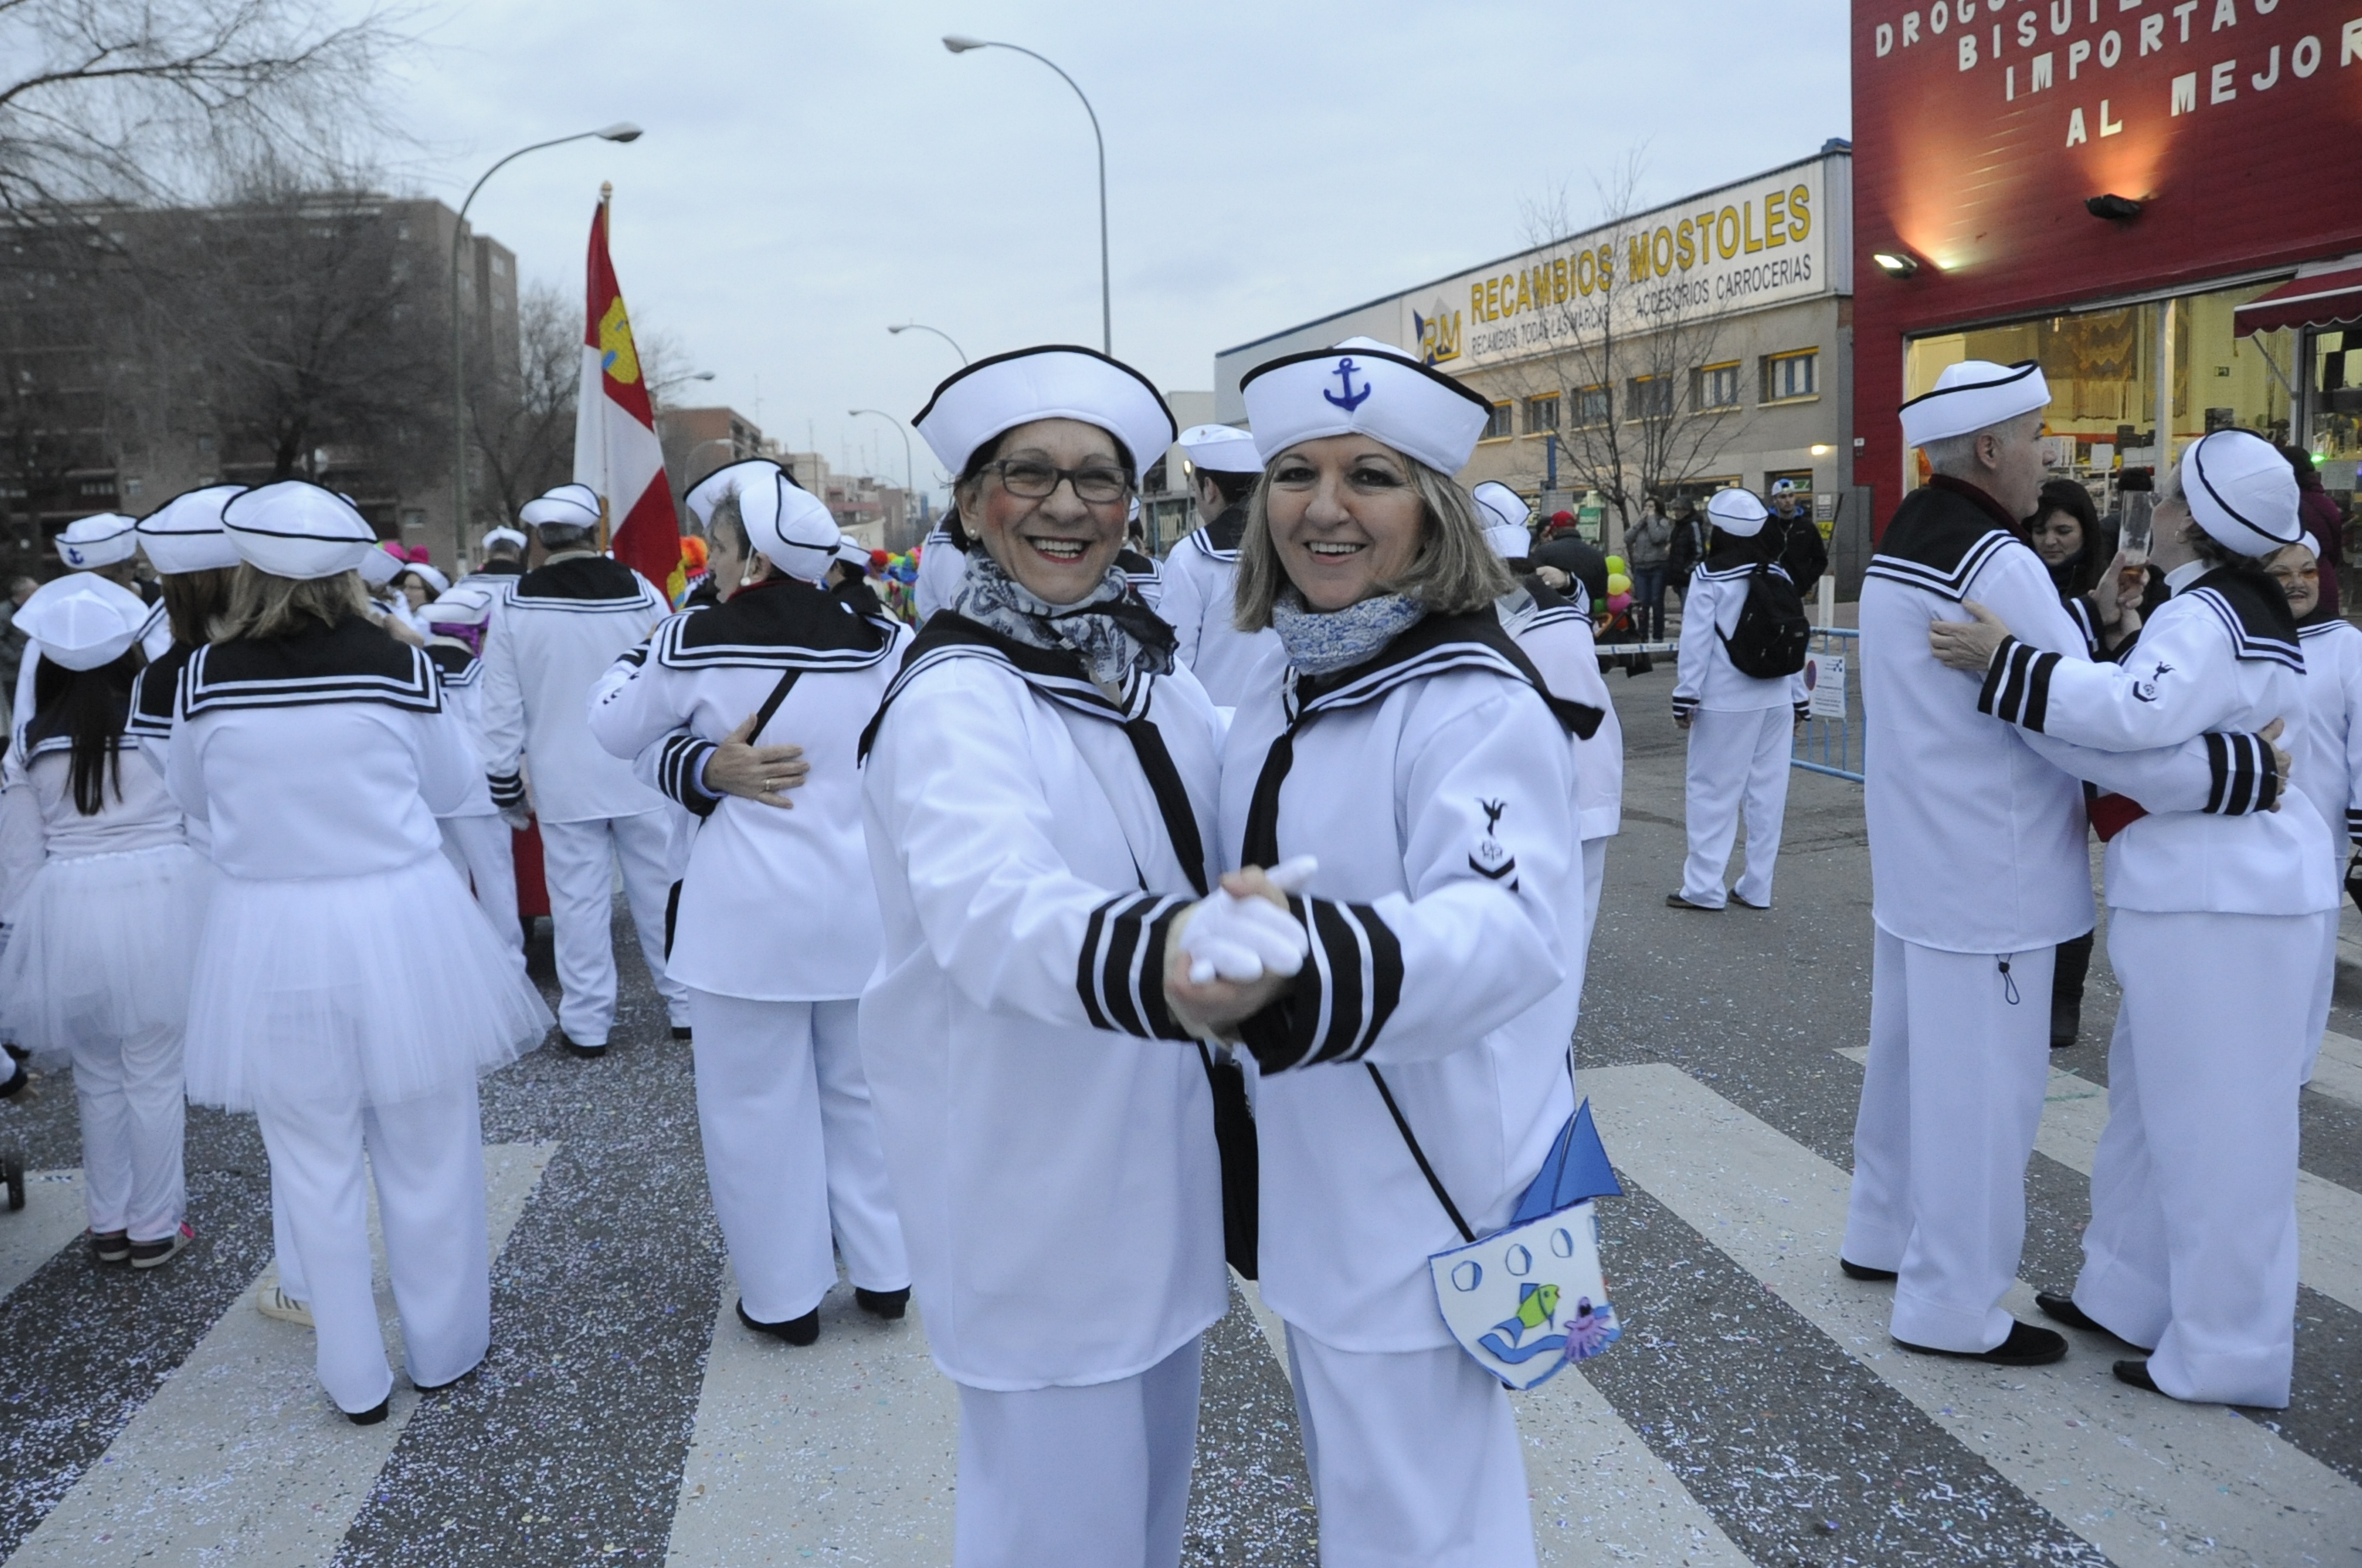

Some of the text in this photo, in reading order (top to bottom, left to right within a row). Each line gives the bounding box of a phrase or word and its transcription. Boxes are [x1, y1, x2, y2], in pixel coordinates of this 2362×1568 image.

[2066, 18, 2362, 148] AL MEJOR
[1471, 183, 1811, 326] RECAMBIOS MOSTOLES
[1471, 327, 1518, 355] RECAMBIOS
[1551, 313, 1569, 339] LAS
[1636, 278, 1710, 318] ACCESORIOS
[1716, 254, 1812, 300] CARROCERIAS
[1423, 311, 1462, 366] RM
